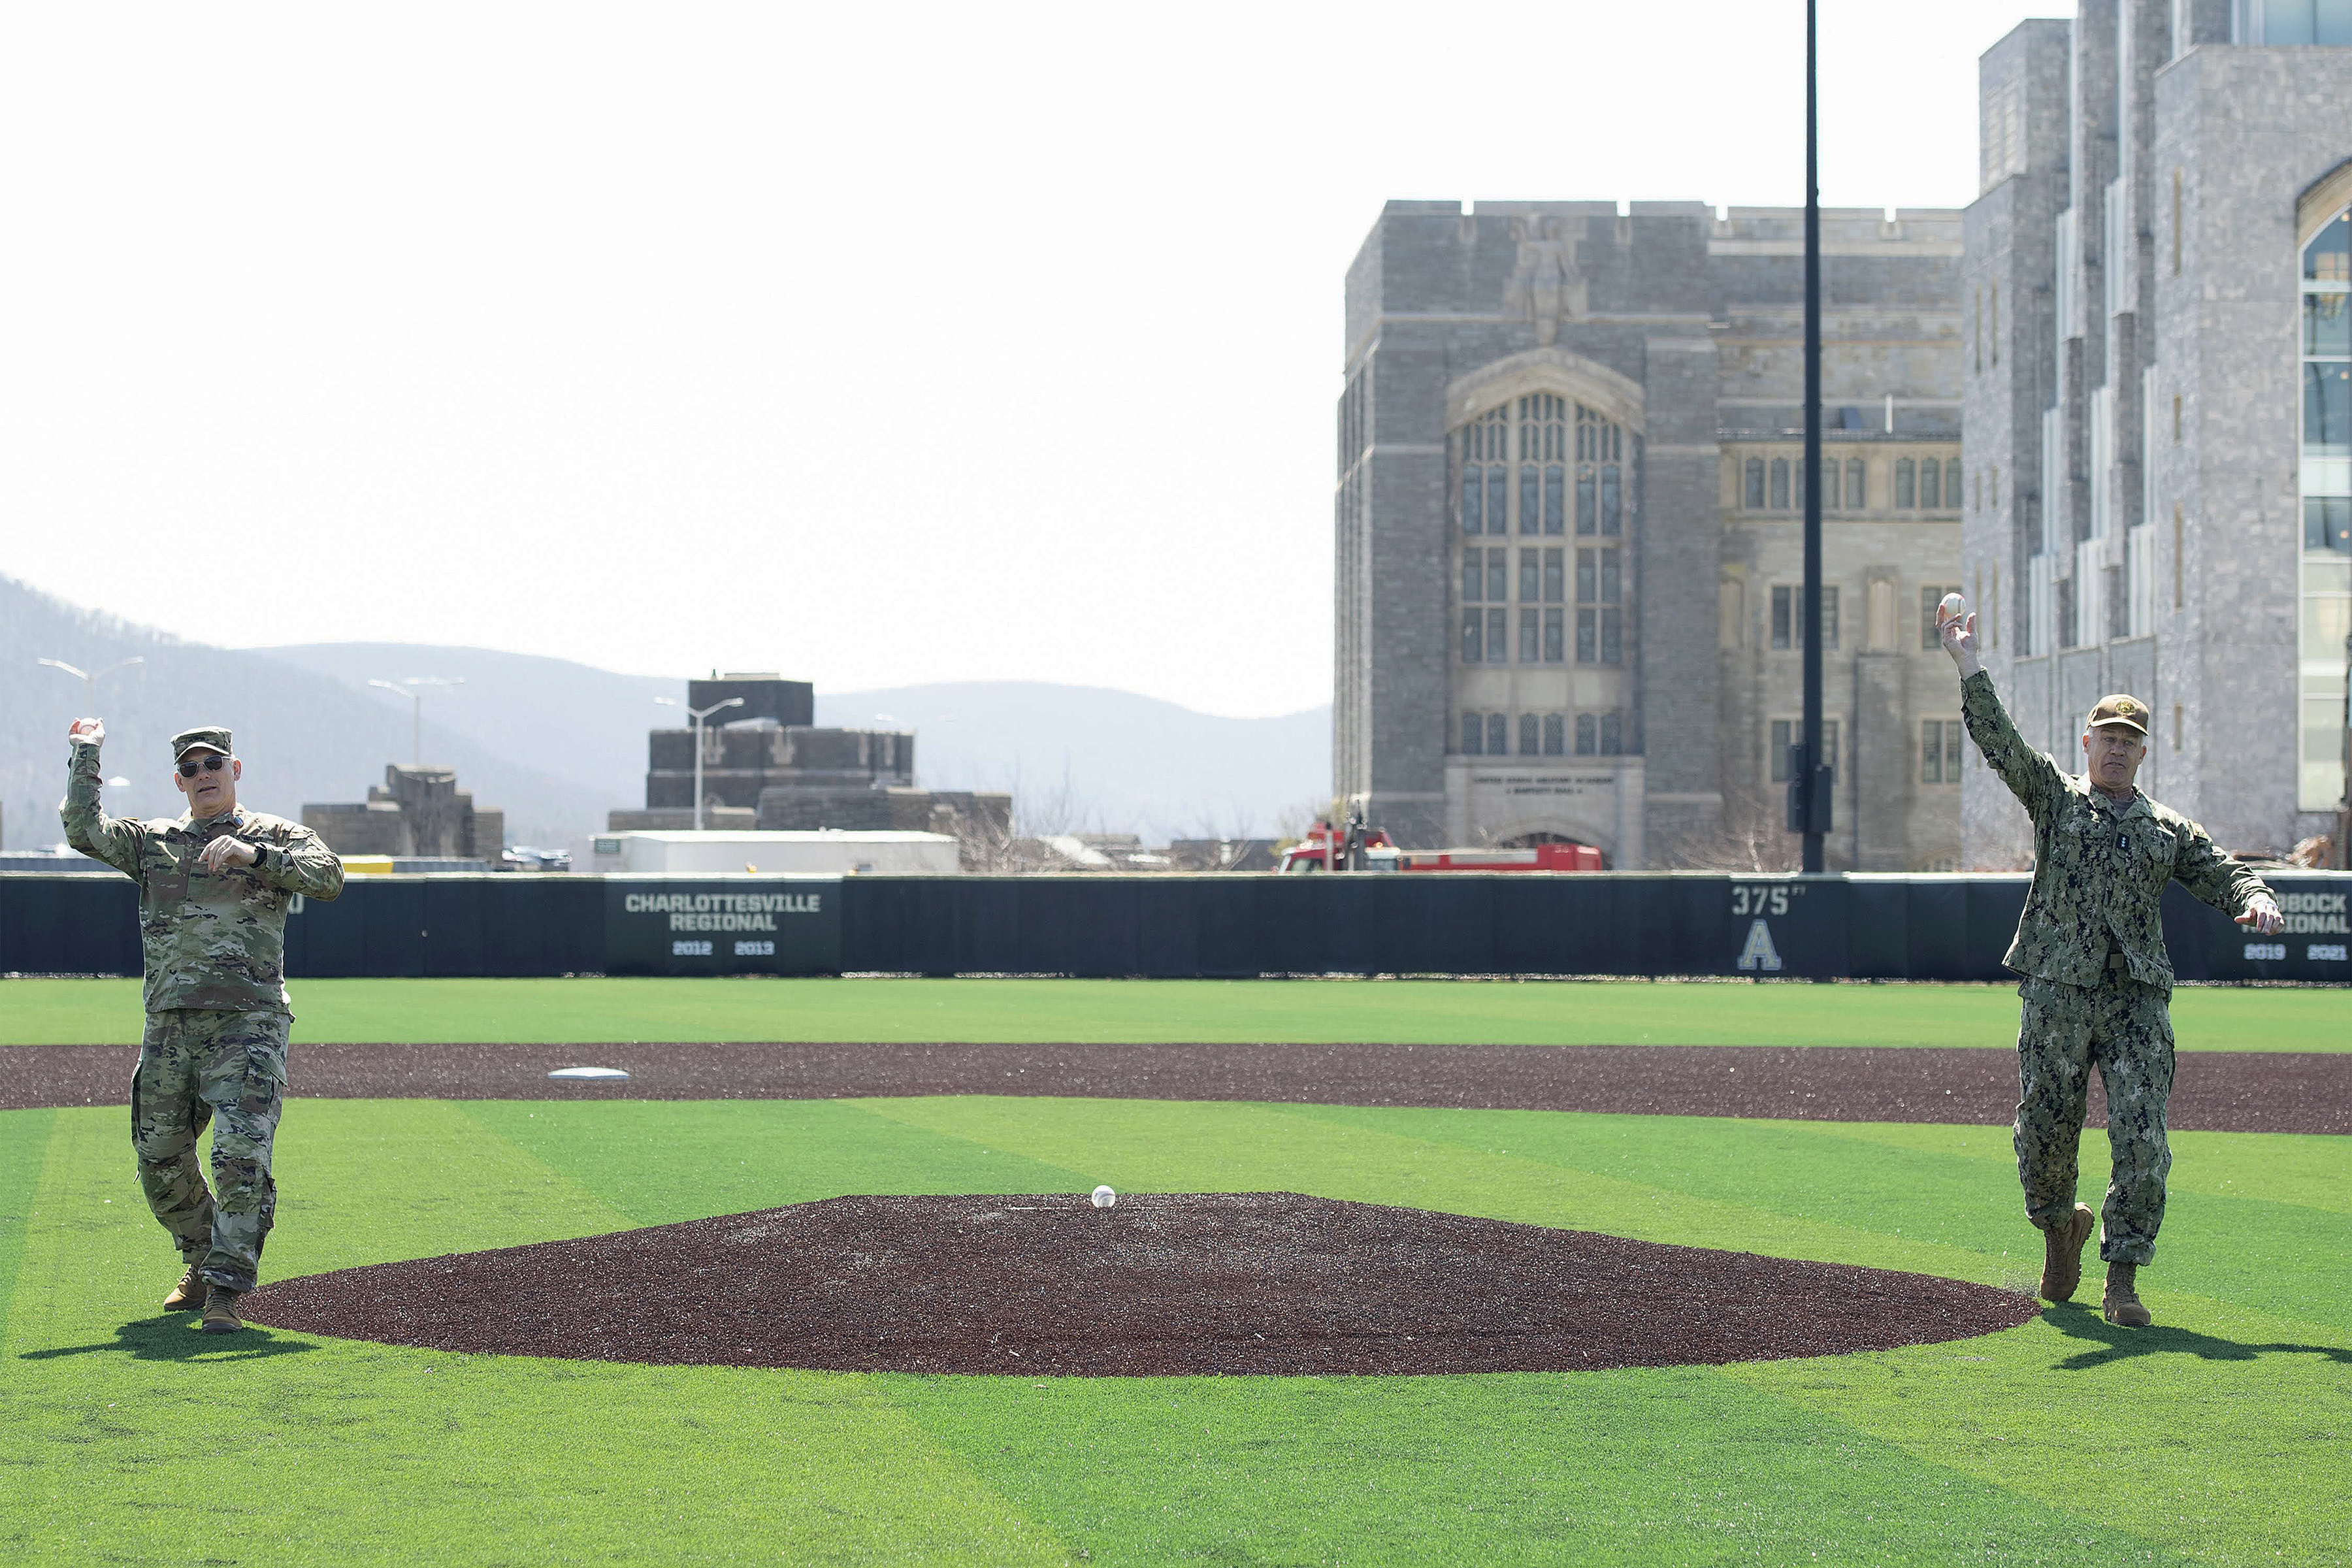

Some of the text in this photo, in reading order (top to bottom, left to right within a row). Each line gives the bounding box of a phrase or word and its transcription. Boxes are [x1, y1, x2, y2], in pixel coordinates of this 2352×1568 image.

[627, 894, 821, 913] CHARLOTTESVILLE
[1732, 885, 1789, 915] 375
[2276, 893, 2347, 913] BBOCK
[670, 914, 776, 931] REGIONAL
[2242, 914, 2351, 934] IONAL
[672, 941, 775, 956] 2012 2013
[2245, 944, 2286, 960] 2019
